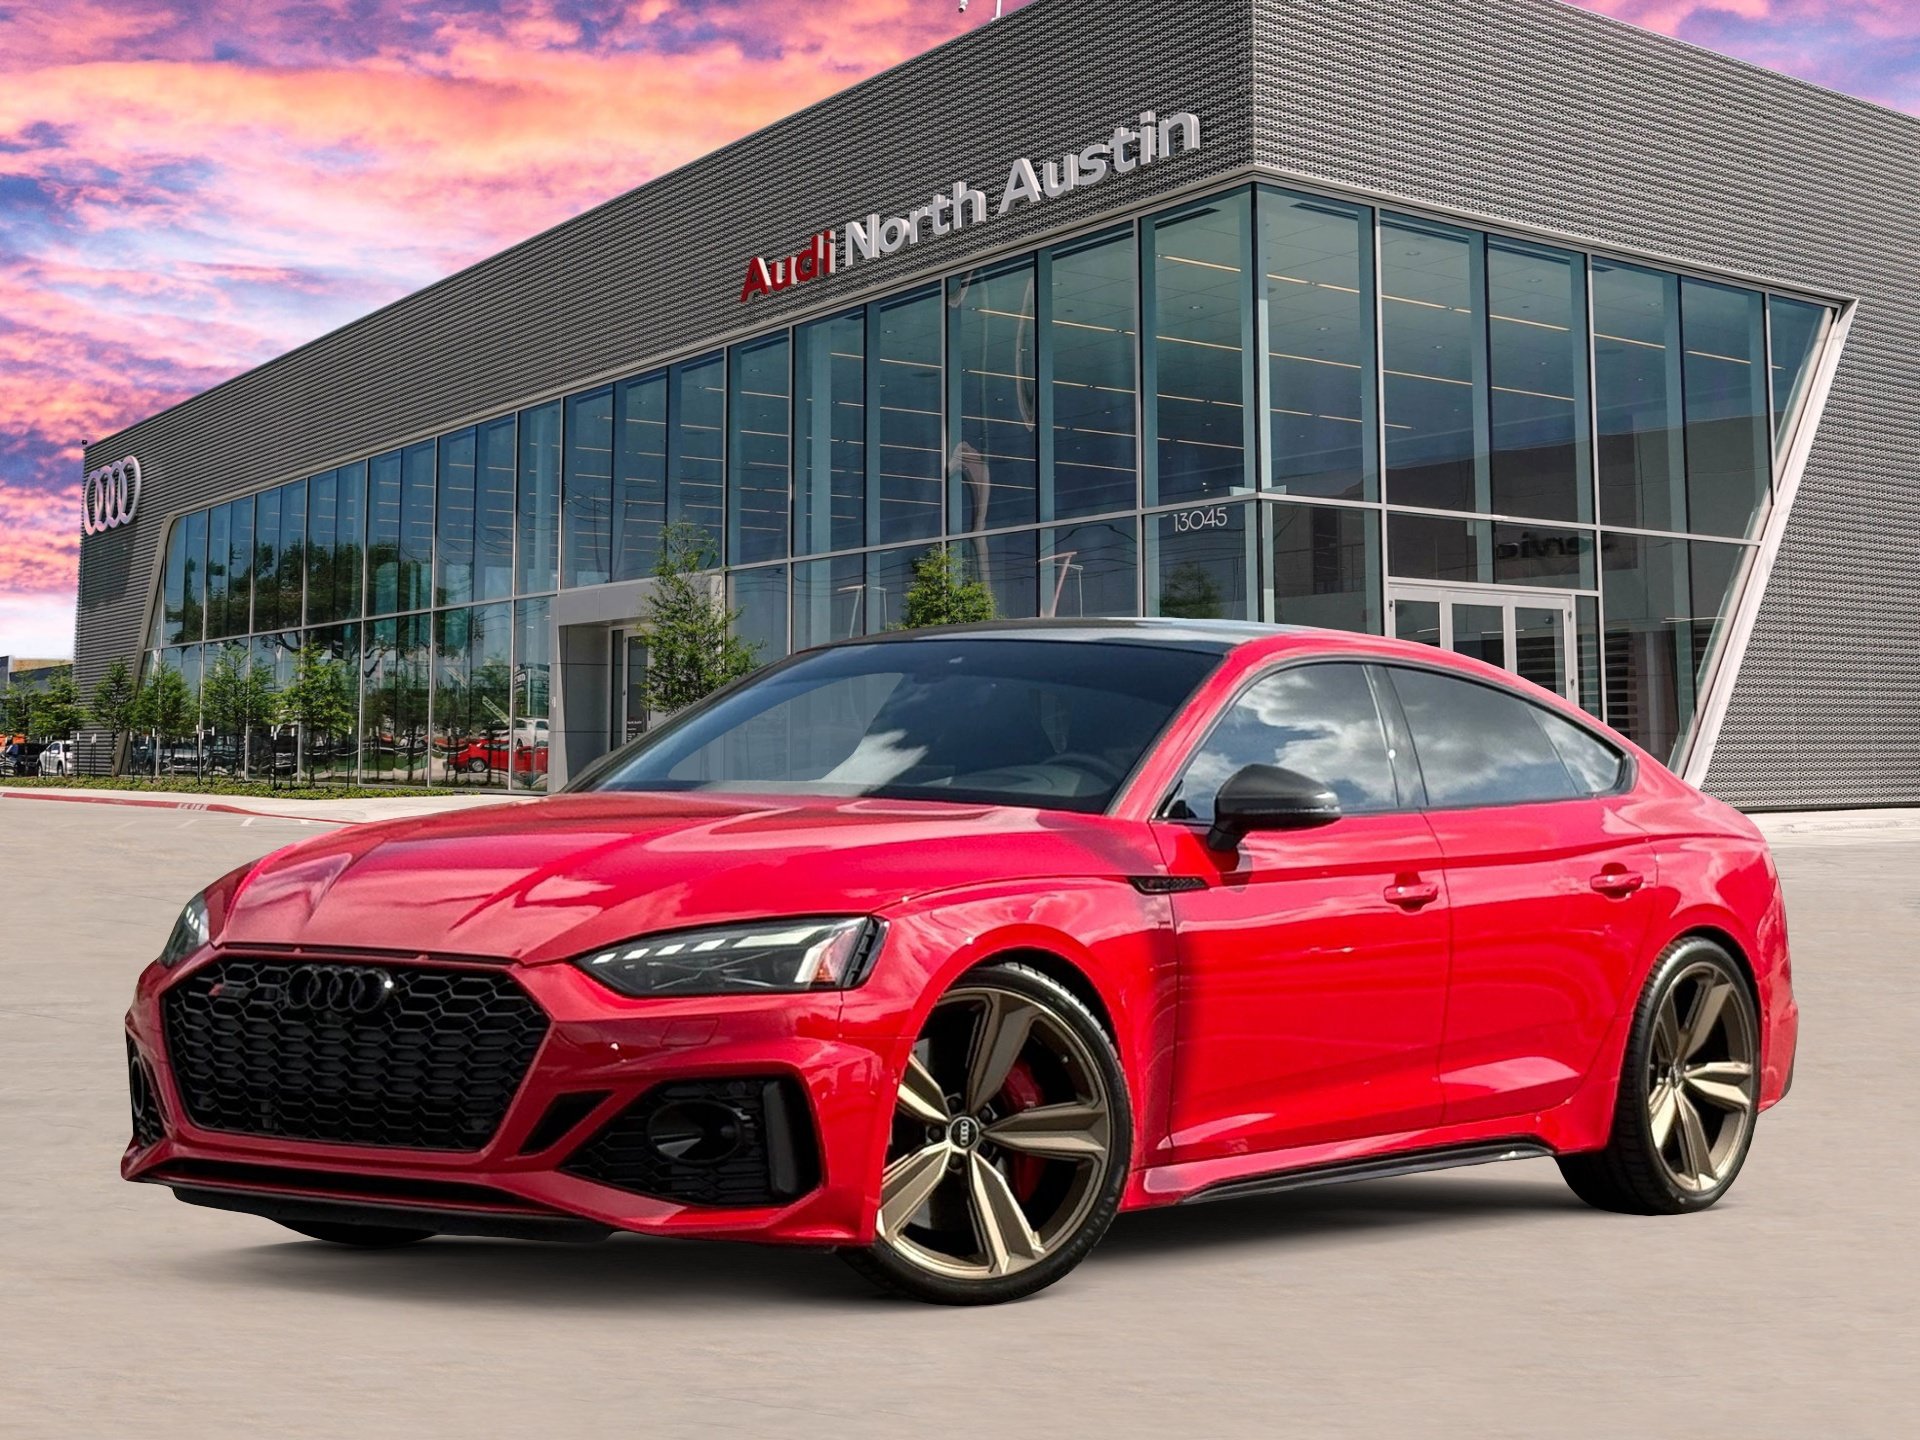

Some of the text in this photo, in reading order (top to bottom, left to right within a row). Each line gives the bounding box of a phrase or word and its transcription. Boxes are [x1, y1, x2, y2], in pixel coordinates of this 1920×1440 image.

[740, 110, 1200, 303] Audi North Austin
[1173, 506, 1228, 532] 13045
